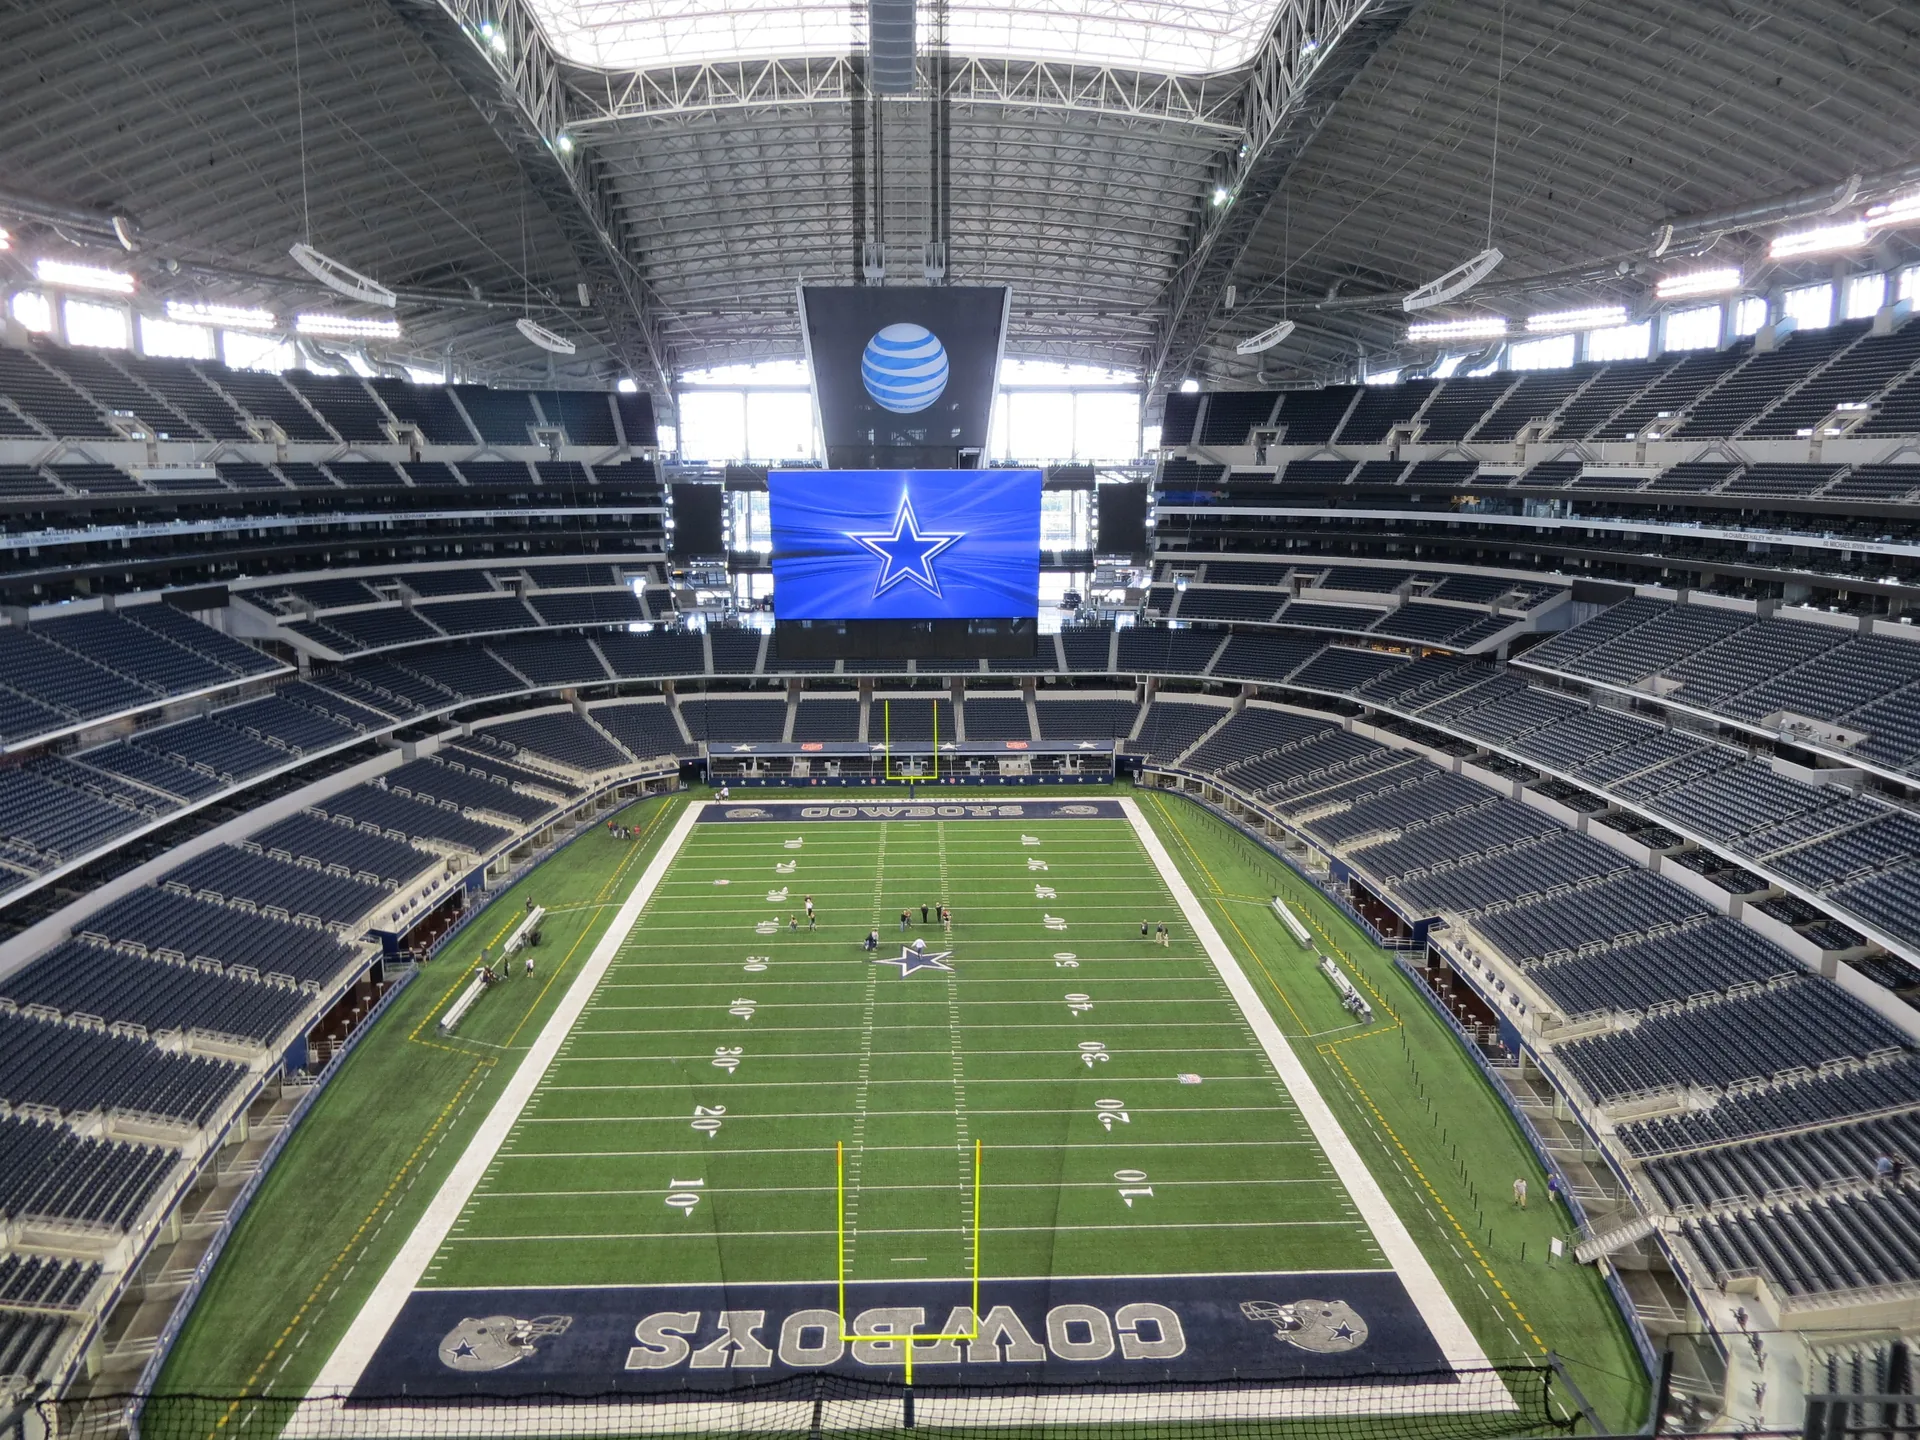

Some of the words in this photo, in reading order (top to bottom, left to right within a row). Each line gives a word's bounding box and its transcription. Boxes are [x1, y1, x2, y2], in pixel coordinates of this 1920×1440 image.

[801, 805, 1024, 817] COWBOYS
[743, 956, 769, 972] 50
[1053, 952, 1079, 968] 50
[729, 998, 757, 1015] 40
[1064, 993, 1093, 1011] 40
[712, 1046, 743, 1067] 30
[1078, 1041, 1109, 1062] 30
[691, 1105, 726, 1130] 20
[1095, 1099, 1130, 1123] 20
[665, 1178, 704, 1207] 10
[1114, 1169, 1153, 1197] 10
[625, 1303, 1186, 1370] COWBOYS
